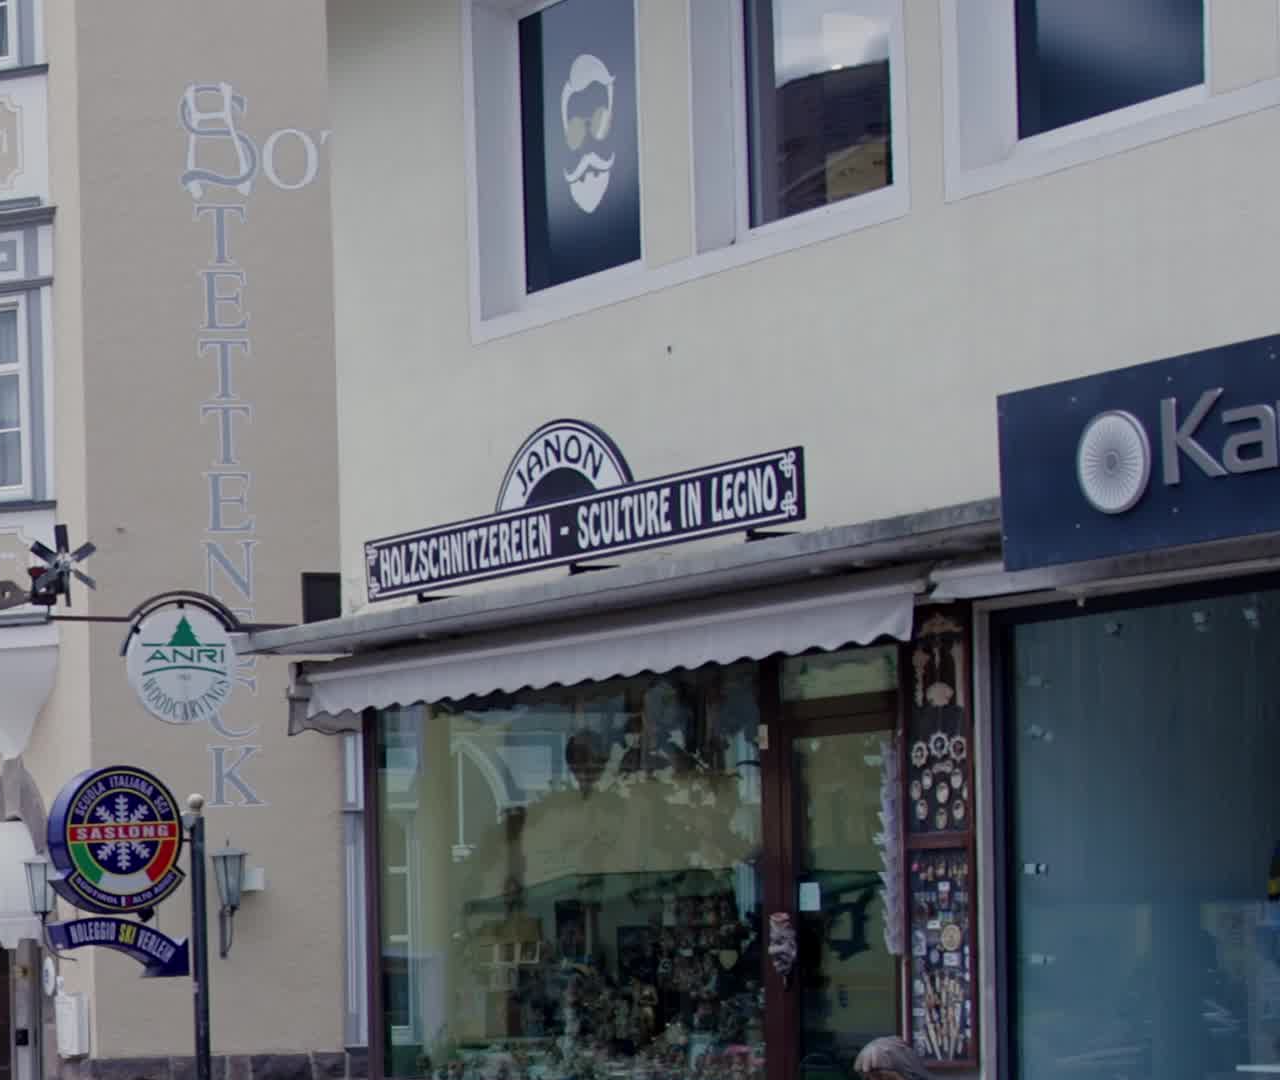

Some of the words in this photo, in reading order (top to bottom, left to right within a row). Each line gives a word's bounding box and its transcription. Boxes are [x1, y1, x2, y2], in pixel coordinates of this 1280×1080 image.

[1160, 386, 1280, 485] Ka
[516, 434, 604, 497] JANON
[380, 513, 552, 588] HOLZSCHNITZEREIEN
[577, 488, 672, 549] SCULTURE
[680, 481, 702, 529] IN
[711, 465, 778, 522] LEGNO
[146, 649, 225, 663] ANRI
[76, 823, 170, 841] SASLONG
[118, 923, 137, 945] SKI
